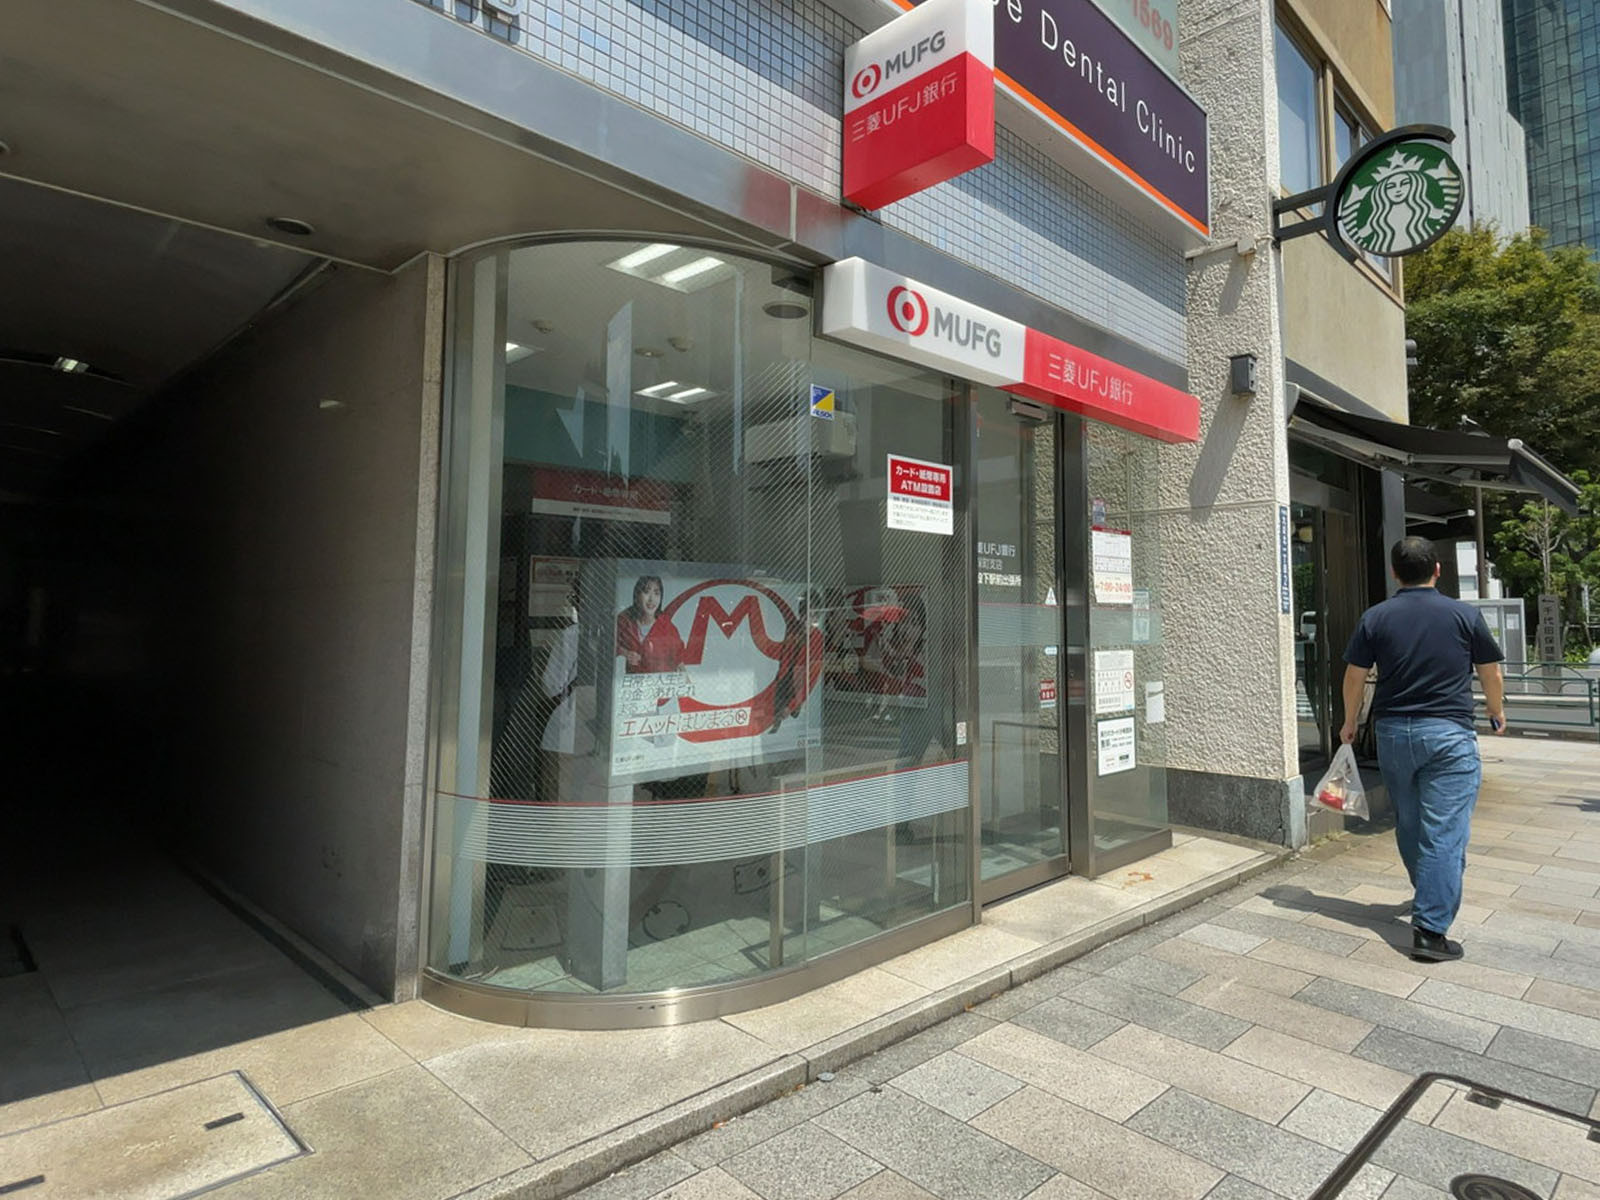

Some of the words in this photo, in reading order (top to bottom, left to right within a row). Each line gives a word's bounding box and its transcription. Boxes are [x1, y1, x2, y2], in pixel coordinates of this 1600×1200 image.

[885, 29, 946, 79] MUFG
[851, 70, 958, 143] 三菱UFJ銀行
[1040, 9, 1126, 113] Dental
[1136, 99, 1196, 174] Clinic
[934, 305, 1002, 359] MUFG
[1047, 351, 1133, 407] 三菱UFJ銀行
